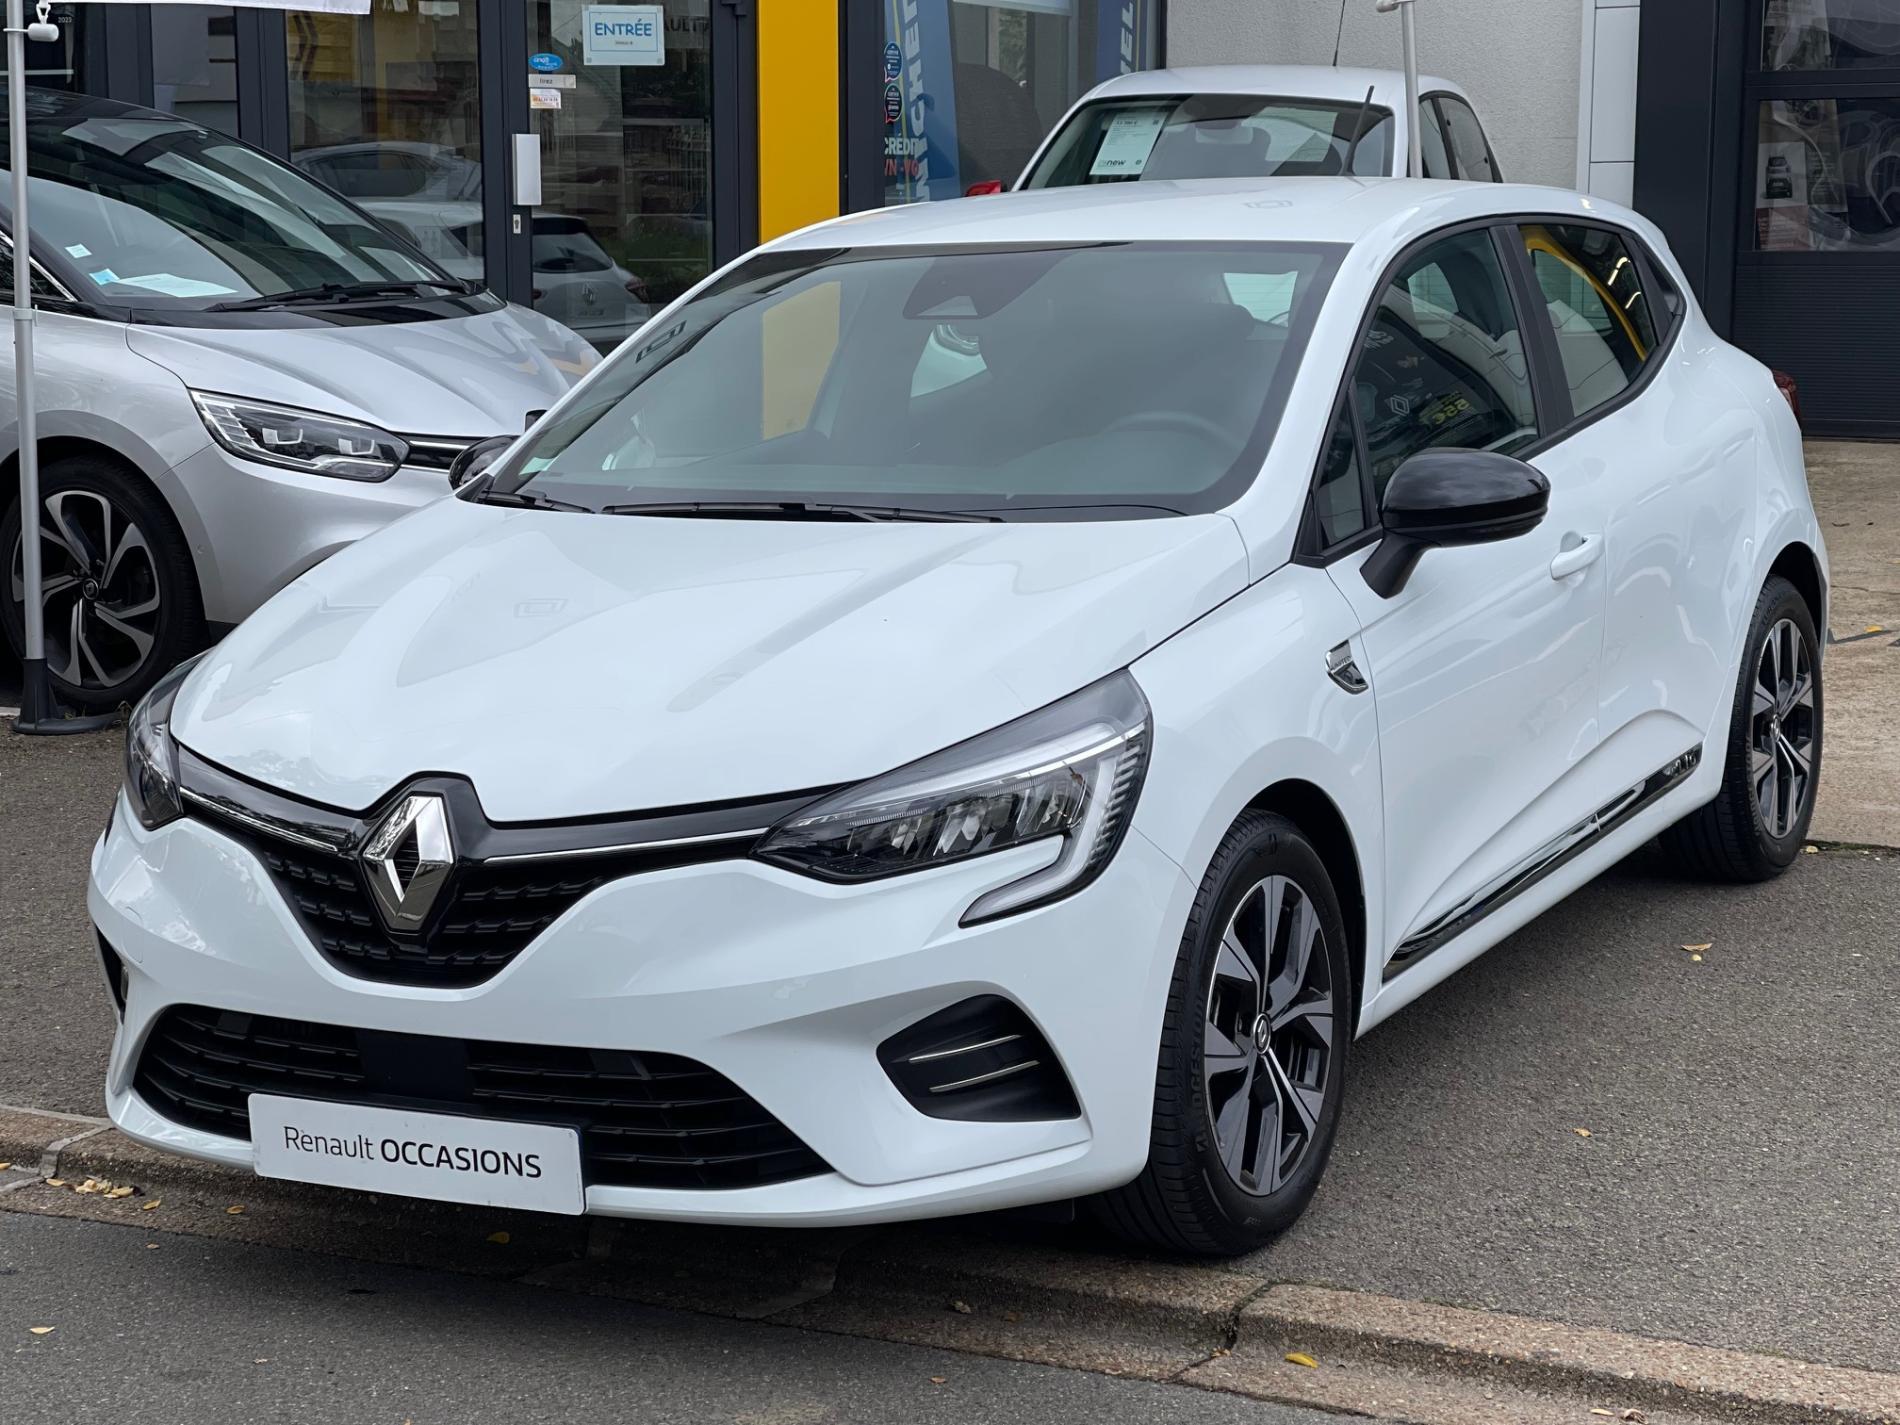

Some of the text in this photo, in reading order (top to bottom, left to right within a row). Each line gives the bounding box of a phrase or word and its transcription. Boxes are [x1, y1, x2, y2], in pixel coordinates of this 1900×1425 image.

[594, 18, 653, 37] ENTRÉE
[283, 1125, 542, 1179] Renault OCCASIONS
